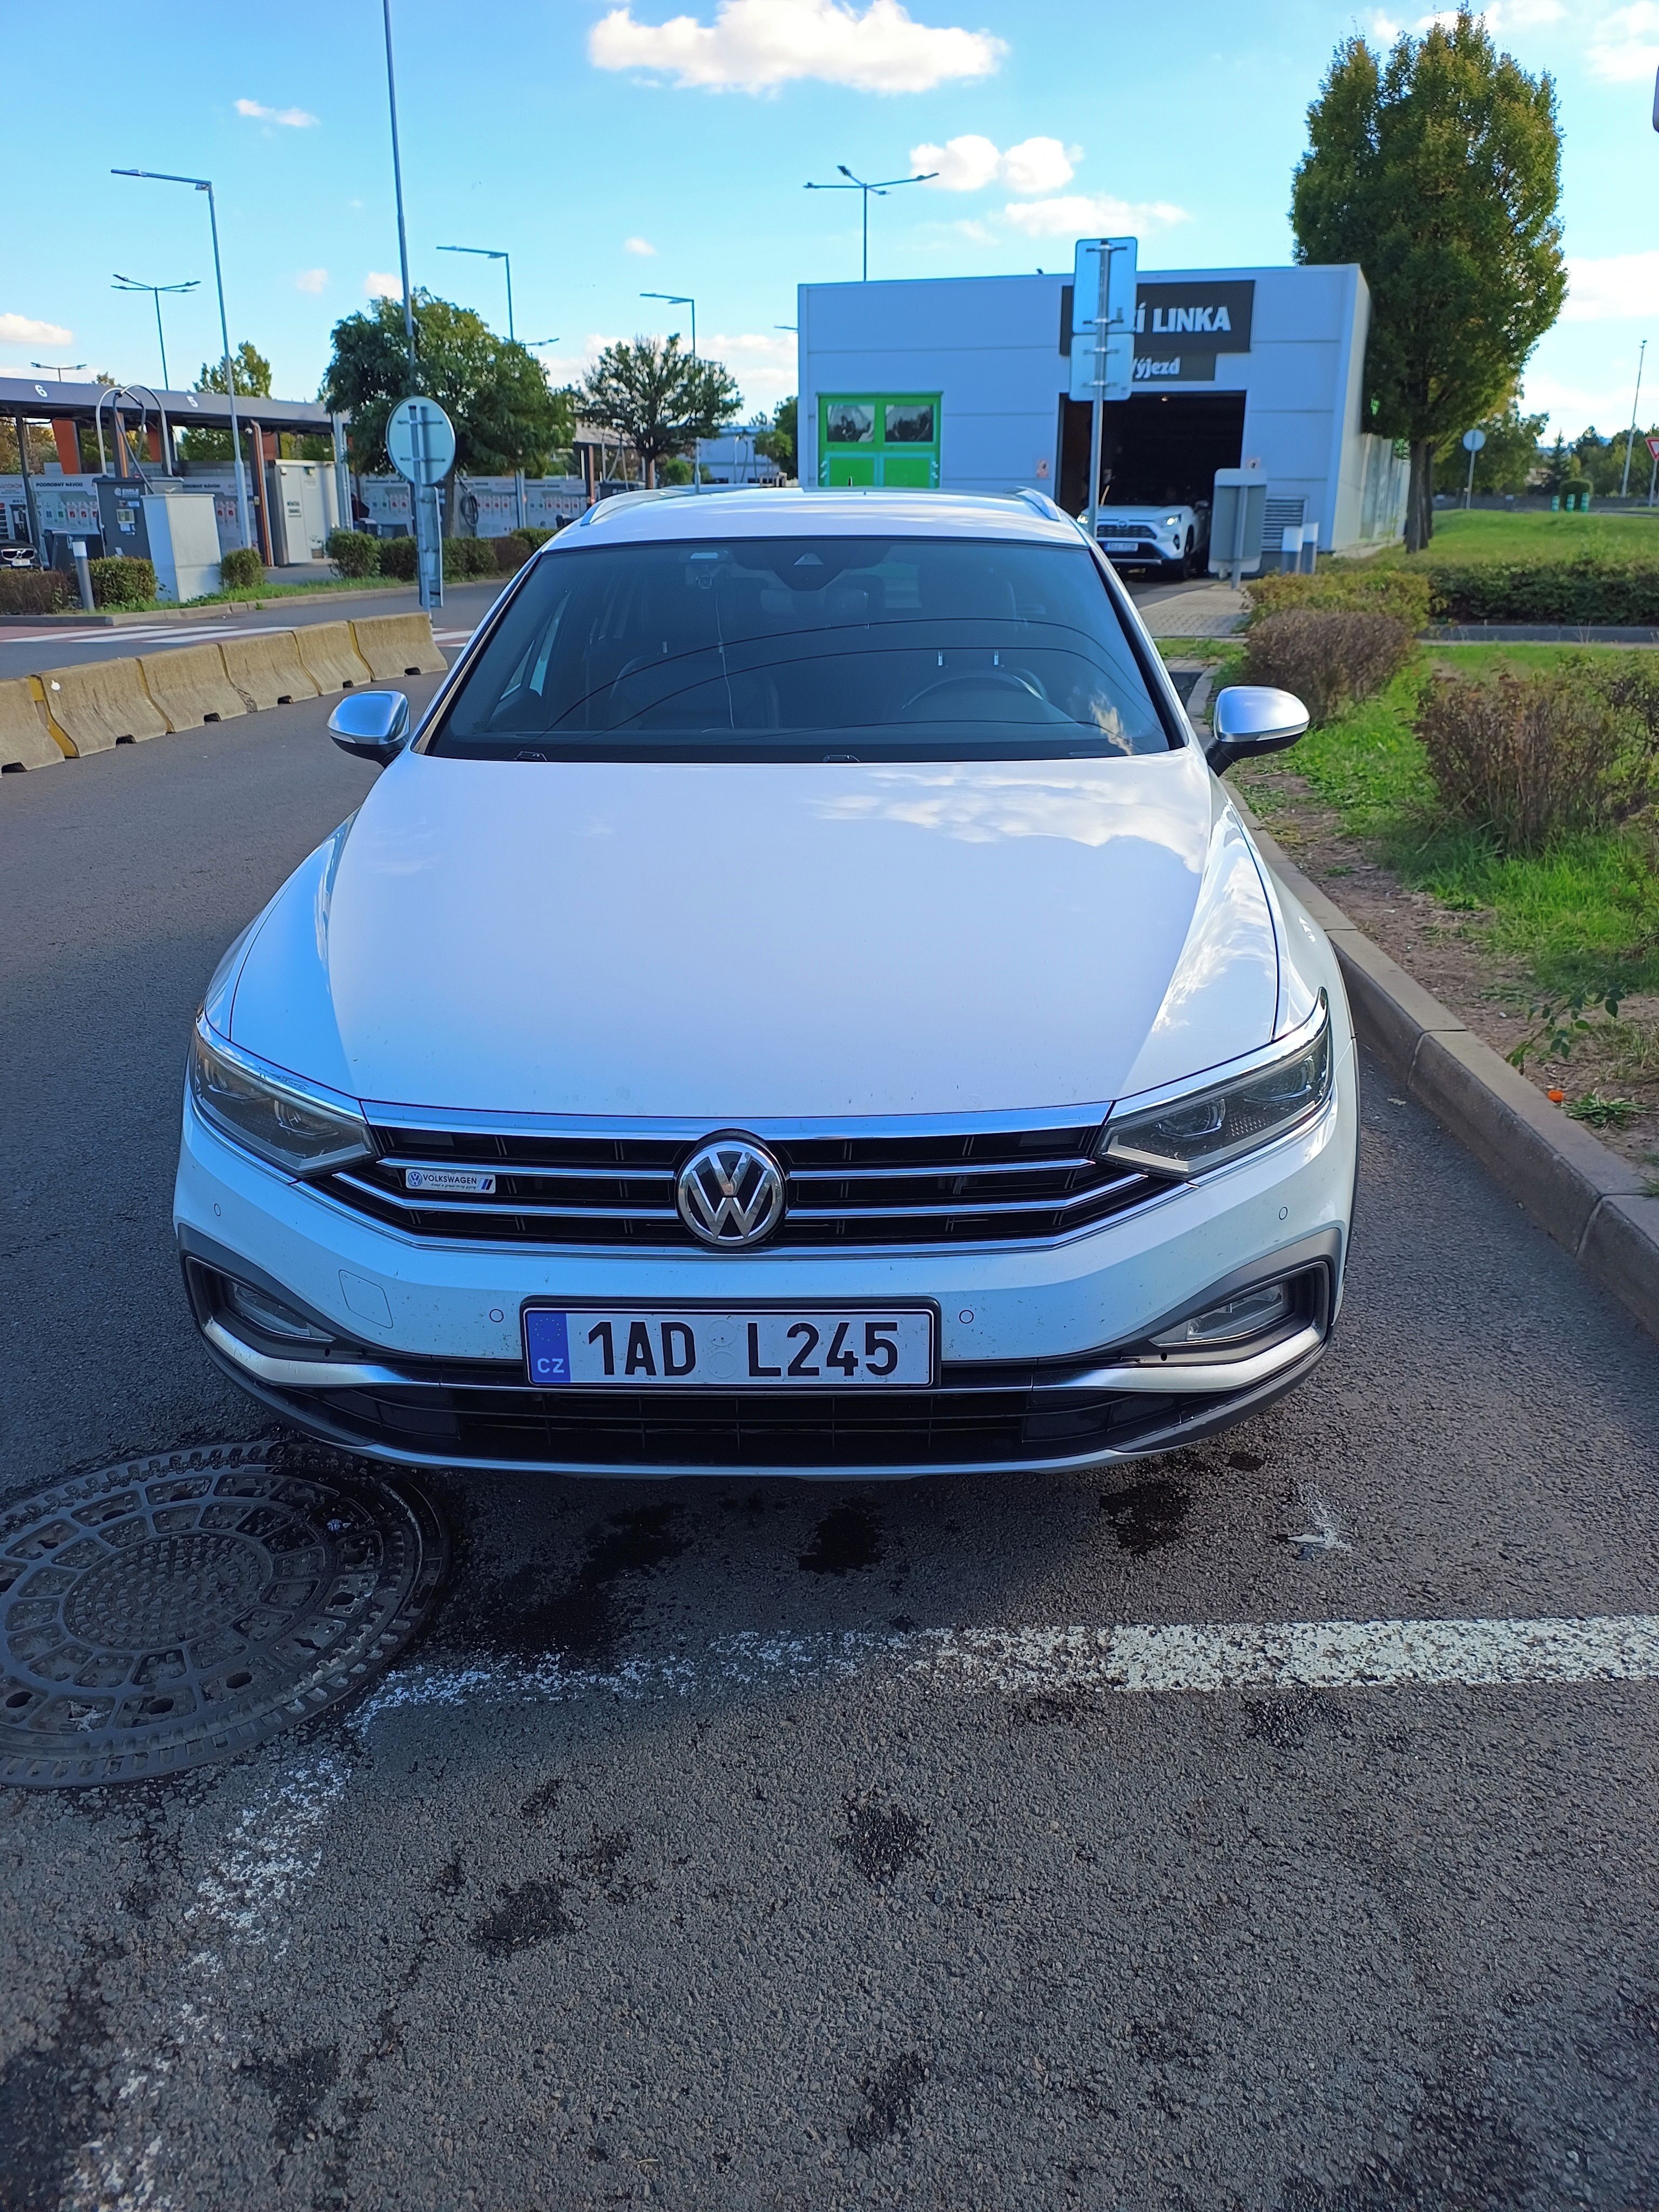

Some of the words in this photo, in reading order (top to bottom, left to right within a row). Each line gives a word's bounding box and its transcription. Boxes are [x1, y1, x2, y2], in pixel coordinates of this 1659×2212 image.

[1152, 306, 1232, 333] LINKA
[35, 384, 48, 397] 6
[187, 395, 199, 408] 5
[423, 1174, 477, 1184] VOLKSWAGEN
[588, 1321, 697, 1377] 1AD
[746, 1321, 899, 1377] L245
[537, 1358, 565, 1374] CZ
